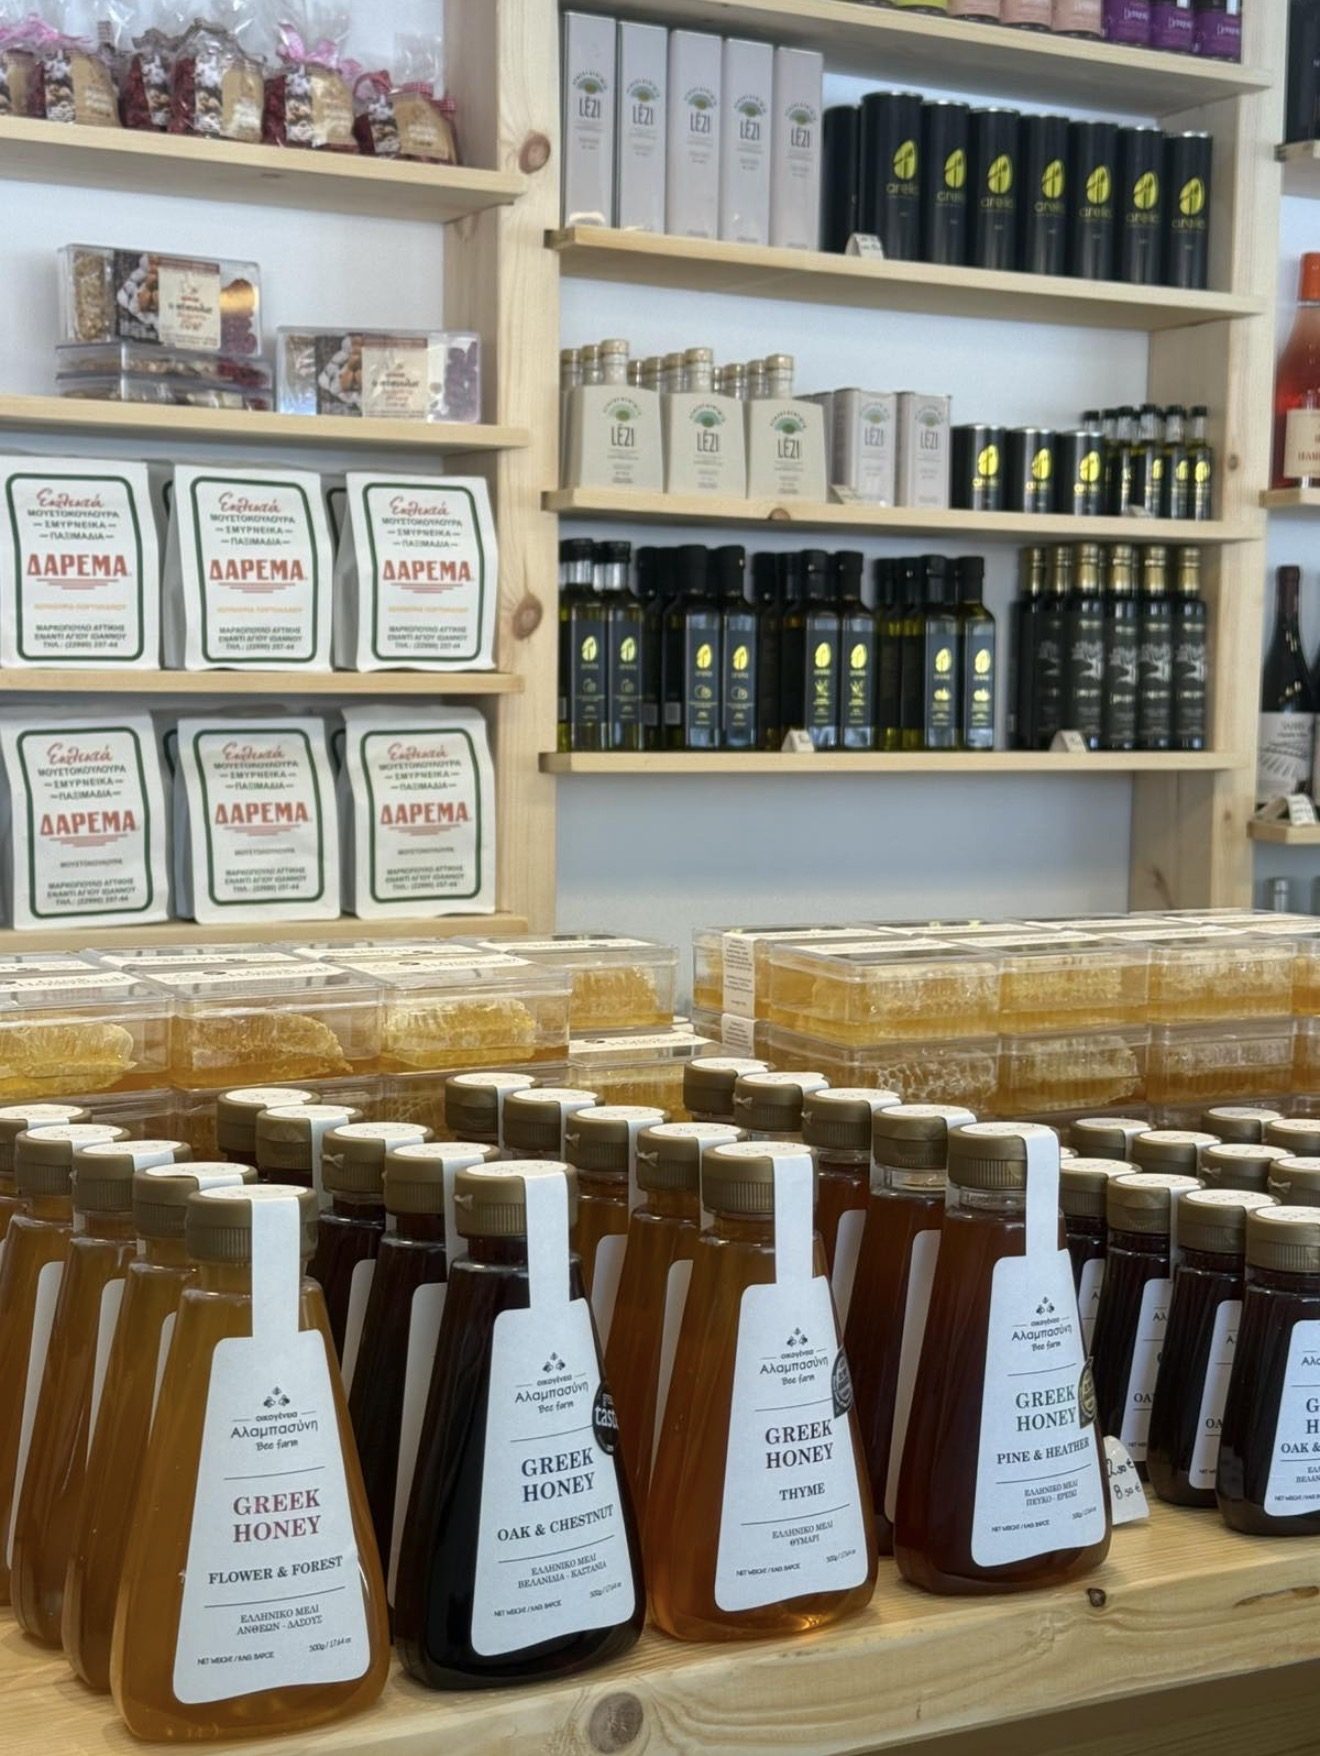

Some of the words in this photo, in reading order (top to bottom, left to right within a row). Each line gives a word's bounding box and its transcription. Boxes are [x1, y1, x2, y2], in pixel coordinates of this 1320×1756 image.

[27, 554, 128, 576] ΔΑΡΕΜΑ
[209, 559, 304, 580] ΔΑΡΕΜΑ
[382, 560, 471, 581] ΔΑΡΕΜΑ
[40, 810, 136, 835] ΔΑΡΕΜΑ
[214, 802, 309, 825] ΔΑΡΕΜΑ
[380, 802, 470, 825] ΔΑΡΕΜΑ
[1011, 1324, 1072, 1341] Αλαμπασύνη
[760, 1356, 828, 1374] Αλαμπασύνη
[514, 1381, 589, 1403] Αλαμπασύνη
[1016, 1384, 1075, 1409] GREEK
[538, 1405, 553, 1414] Bee
[556, 1399, 574, 1410] farm
[230, 1419, 319, 1439] Αλαμπασύνη
[1016, 1406, 1077, 1433] HONEY
[765, 1419, 832, 1445] GREEK
[256, 1441, 274, 1451] Bee
[276, 1438, 298, 1449] farm
[766, 1442, 834, 1469] HONEY
[996, 1450, 1030, 1465] PINE
[1033, 1449, 1043, 1461] &
[1046, 1437, 1090, 1459] HEATHER
[1280, 1443, 1309, 1454] OAK
[521, 1447, 594, 1477] GREEK
[522, 1472, 595, 1502] HONEY
[779, 1482, 826, 1501] THYME
[233, 1488, 320, 1515] GREEK
[233, 1515, 321, 1543] HONEY
[497, 1525, 531, 1541] OAK
[535, 1524, 546, 1537] &
[549, 1504, 614, 1534] CHESTNUT
[208, 1568, 272, 1584] FLOWER
[277, 1566, 288, 1579] &
[291, 1555, 343, 1575] FOREST
[531, 1559, 576, 1576] ΕΛΛΗΝΙΚΟ
[240, 1609, 293, 1623] ΕΛΛΗΝΙΚΟ
[295, 1604, 319, 1617] ΜΕΛΙ
[237, 1622, 280, 1635] ΑΝΘΕΩΝ
[287, 1615, 323, 1629] ΔΑΣΟΥΣ
